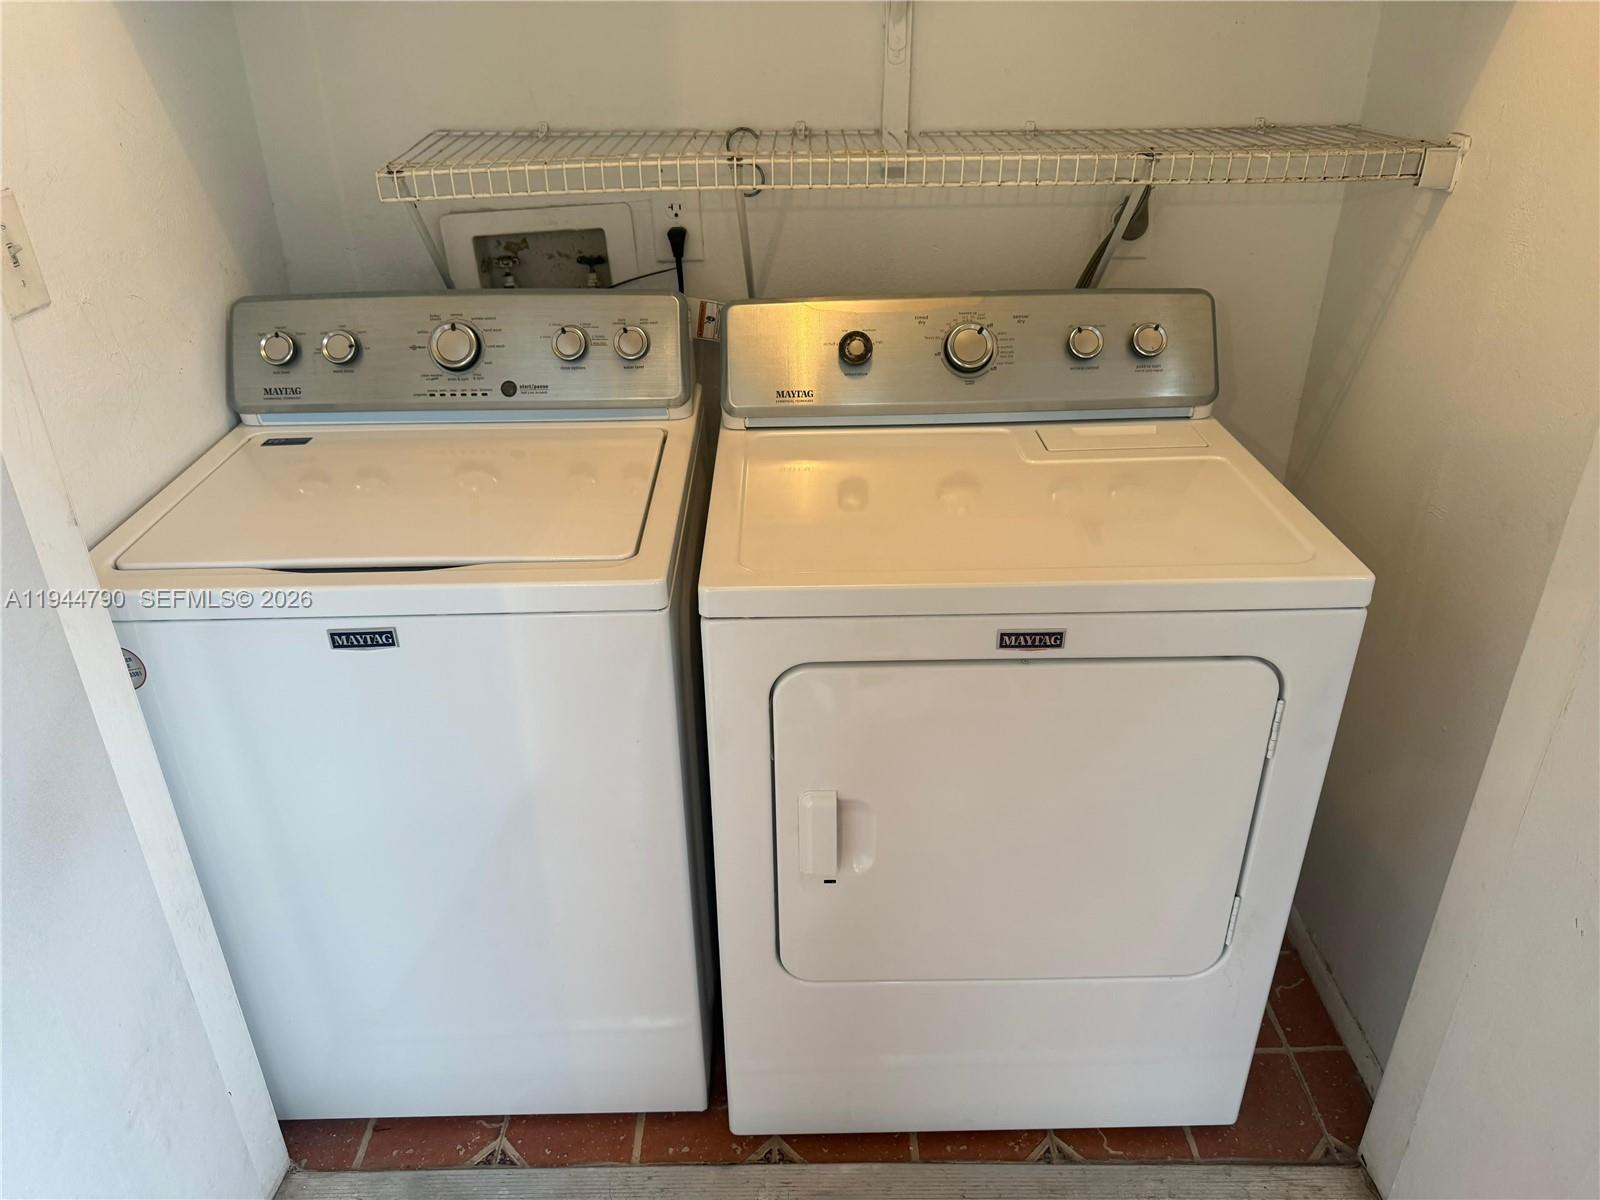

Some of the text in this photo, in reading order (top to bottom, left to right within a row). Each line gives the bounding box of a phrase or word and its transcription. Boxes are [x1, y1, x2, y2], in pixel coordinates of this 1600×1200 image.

[263, 387, 302, 396] MAYTAG
[776, 390, 814, 399] MAYTAG
[333, 633, 393, 646] MAYTAG
[1002, 635, 1061, 646] MAYTAG
